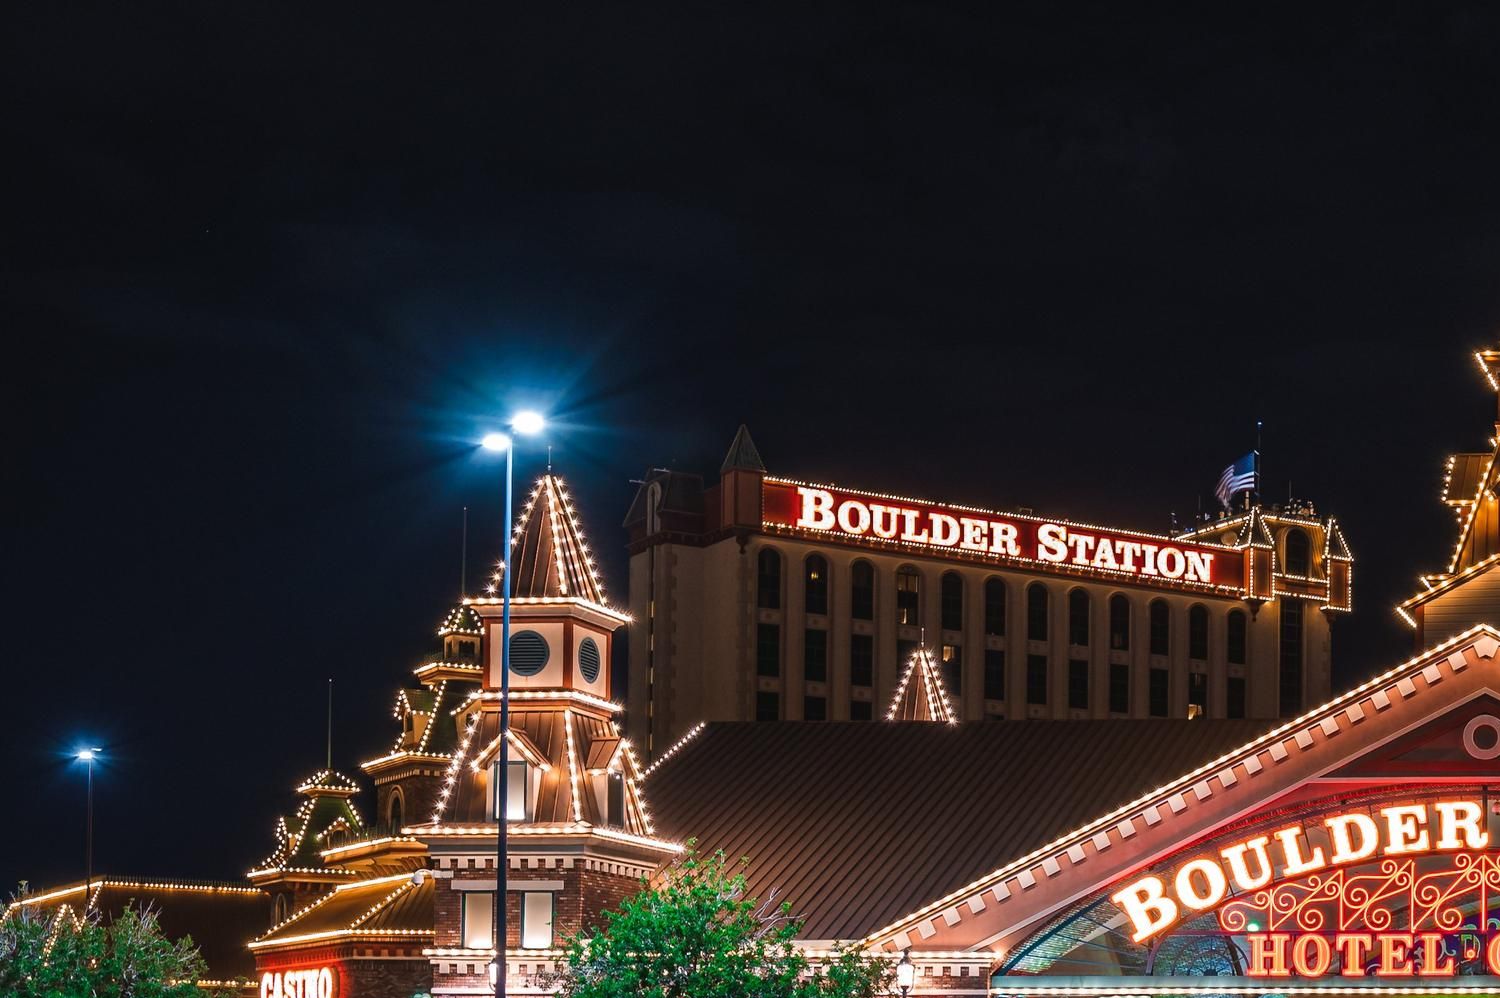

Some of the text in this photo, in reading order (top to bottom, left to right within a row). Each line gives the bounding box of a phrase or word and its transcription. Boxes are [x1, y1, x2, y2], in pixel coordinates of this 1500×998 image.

[797, 486, 1214, 583] BOULDER STATION
[1110, 799, 1489, 944] BOULDER
[1246, 931, 1456, 978] HOTEL
